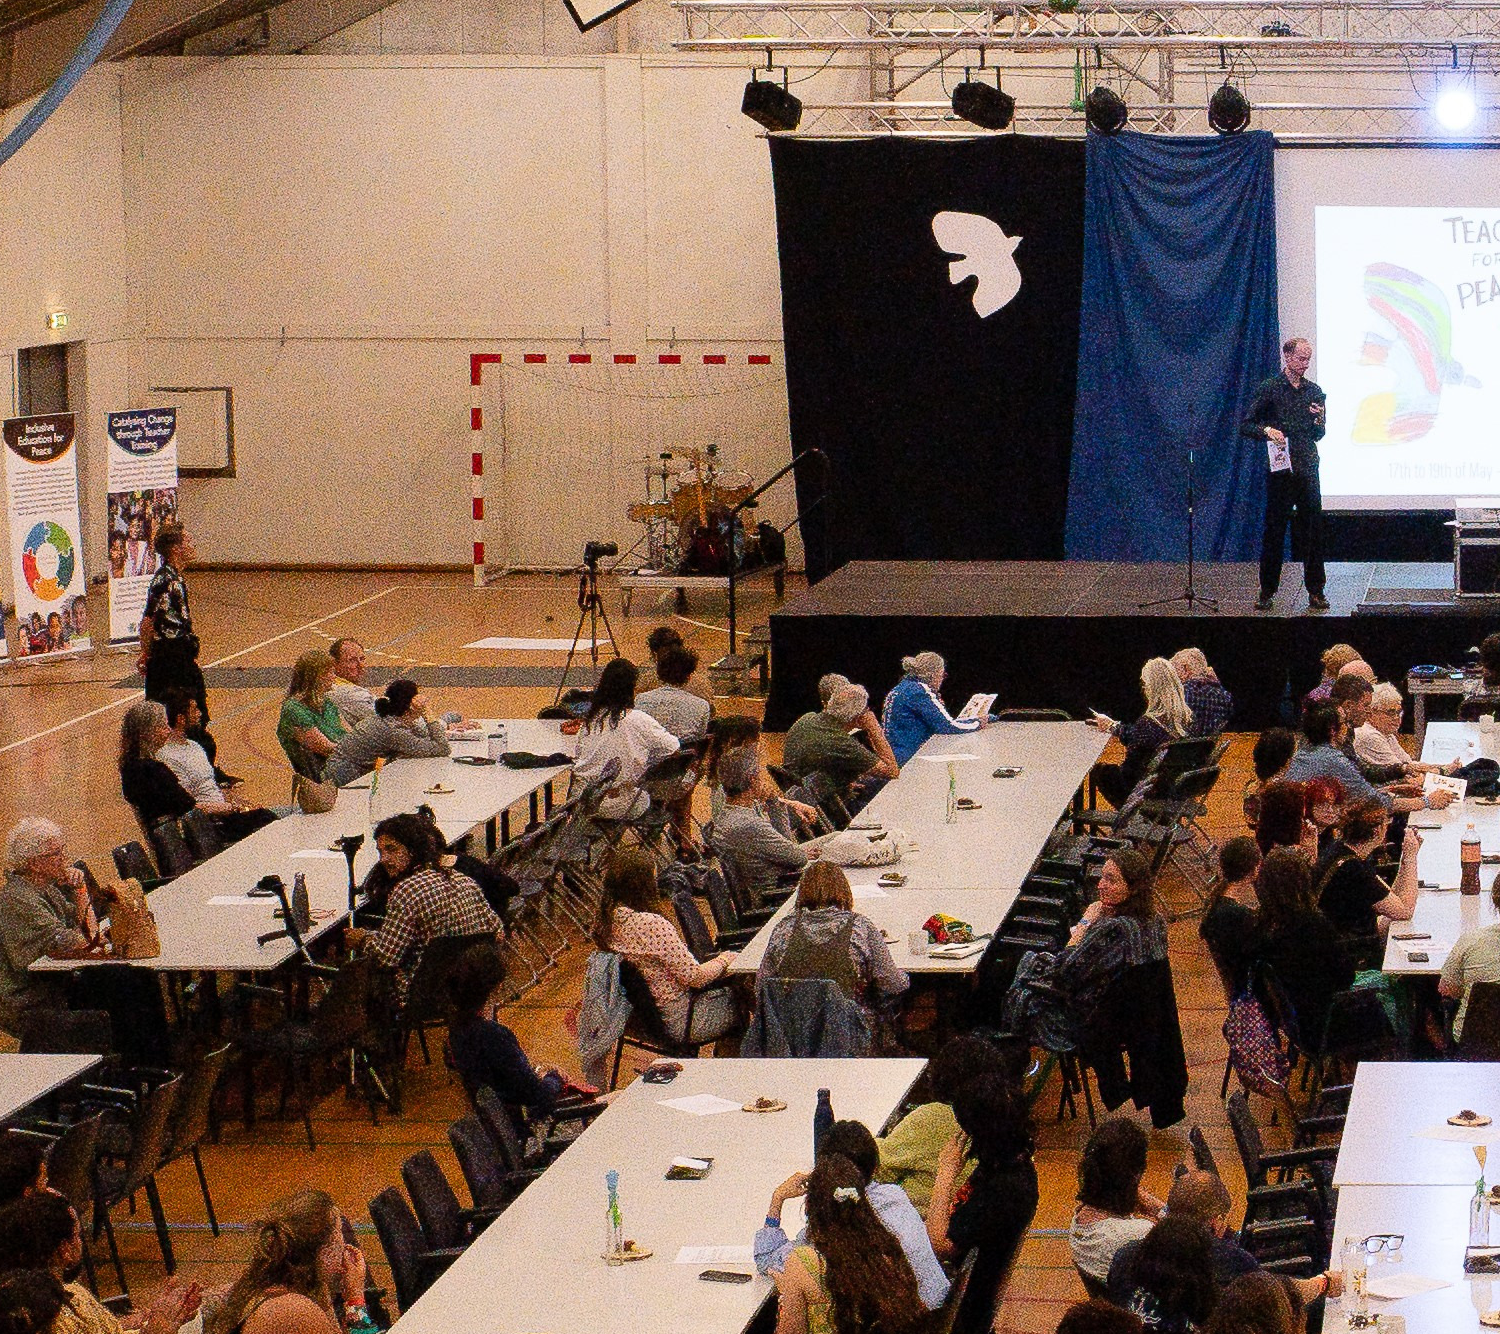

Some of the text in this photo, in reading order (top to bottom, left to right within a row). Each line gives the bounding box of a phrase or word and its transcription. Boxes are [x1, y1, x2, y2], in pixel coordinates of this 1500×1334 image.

[25, 423, 55, 434] Inclusive
[17, 432, 65, 446] Education for
[31, 446, 53, 456] Peace
[1388, 462, 1411, 479] 17th
[1413, 463, 1426, 479] to
[1428, 462, 1452, 479] 19th
[1454, 462, 1467, 479] of
[1469, 462, 1493, 482] May
